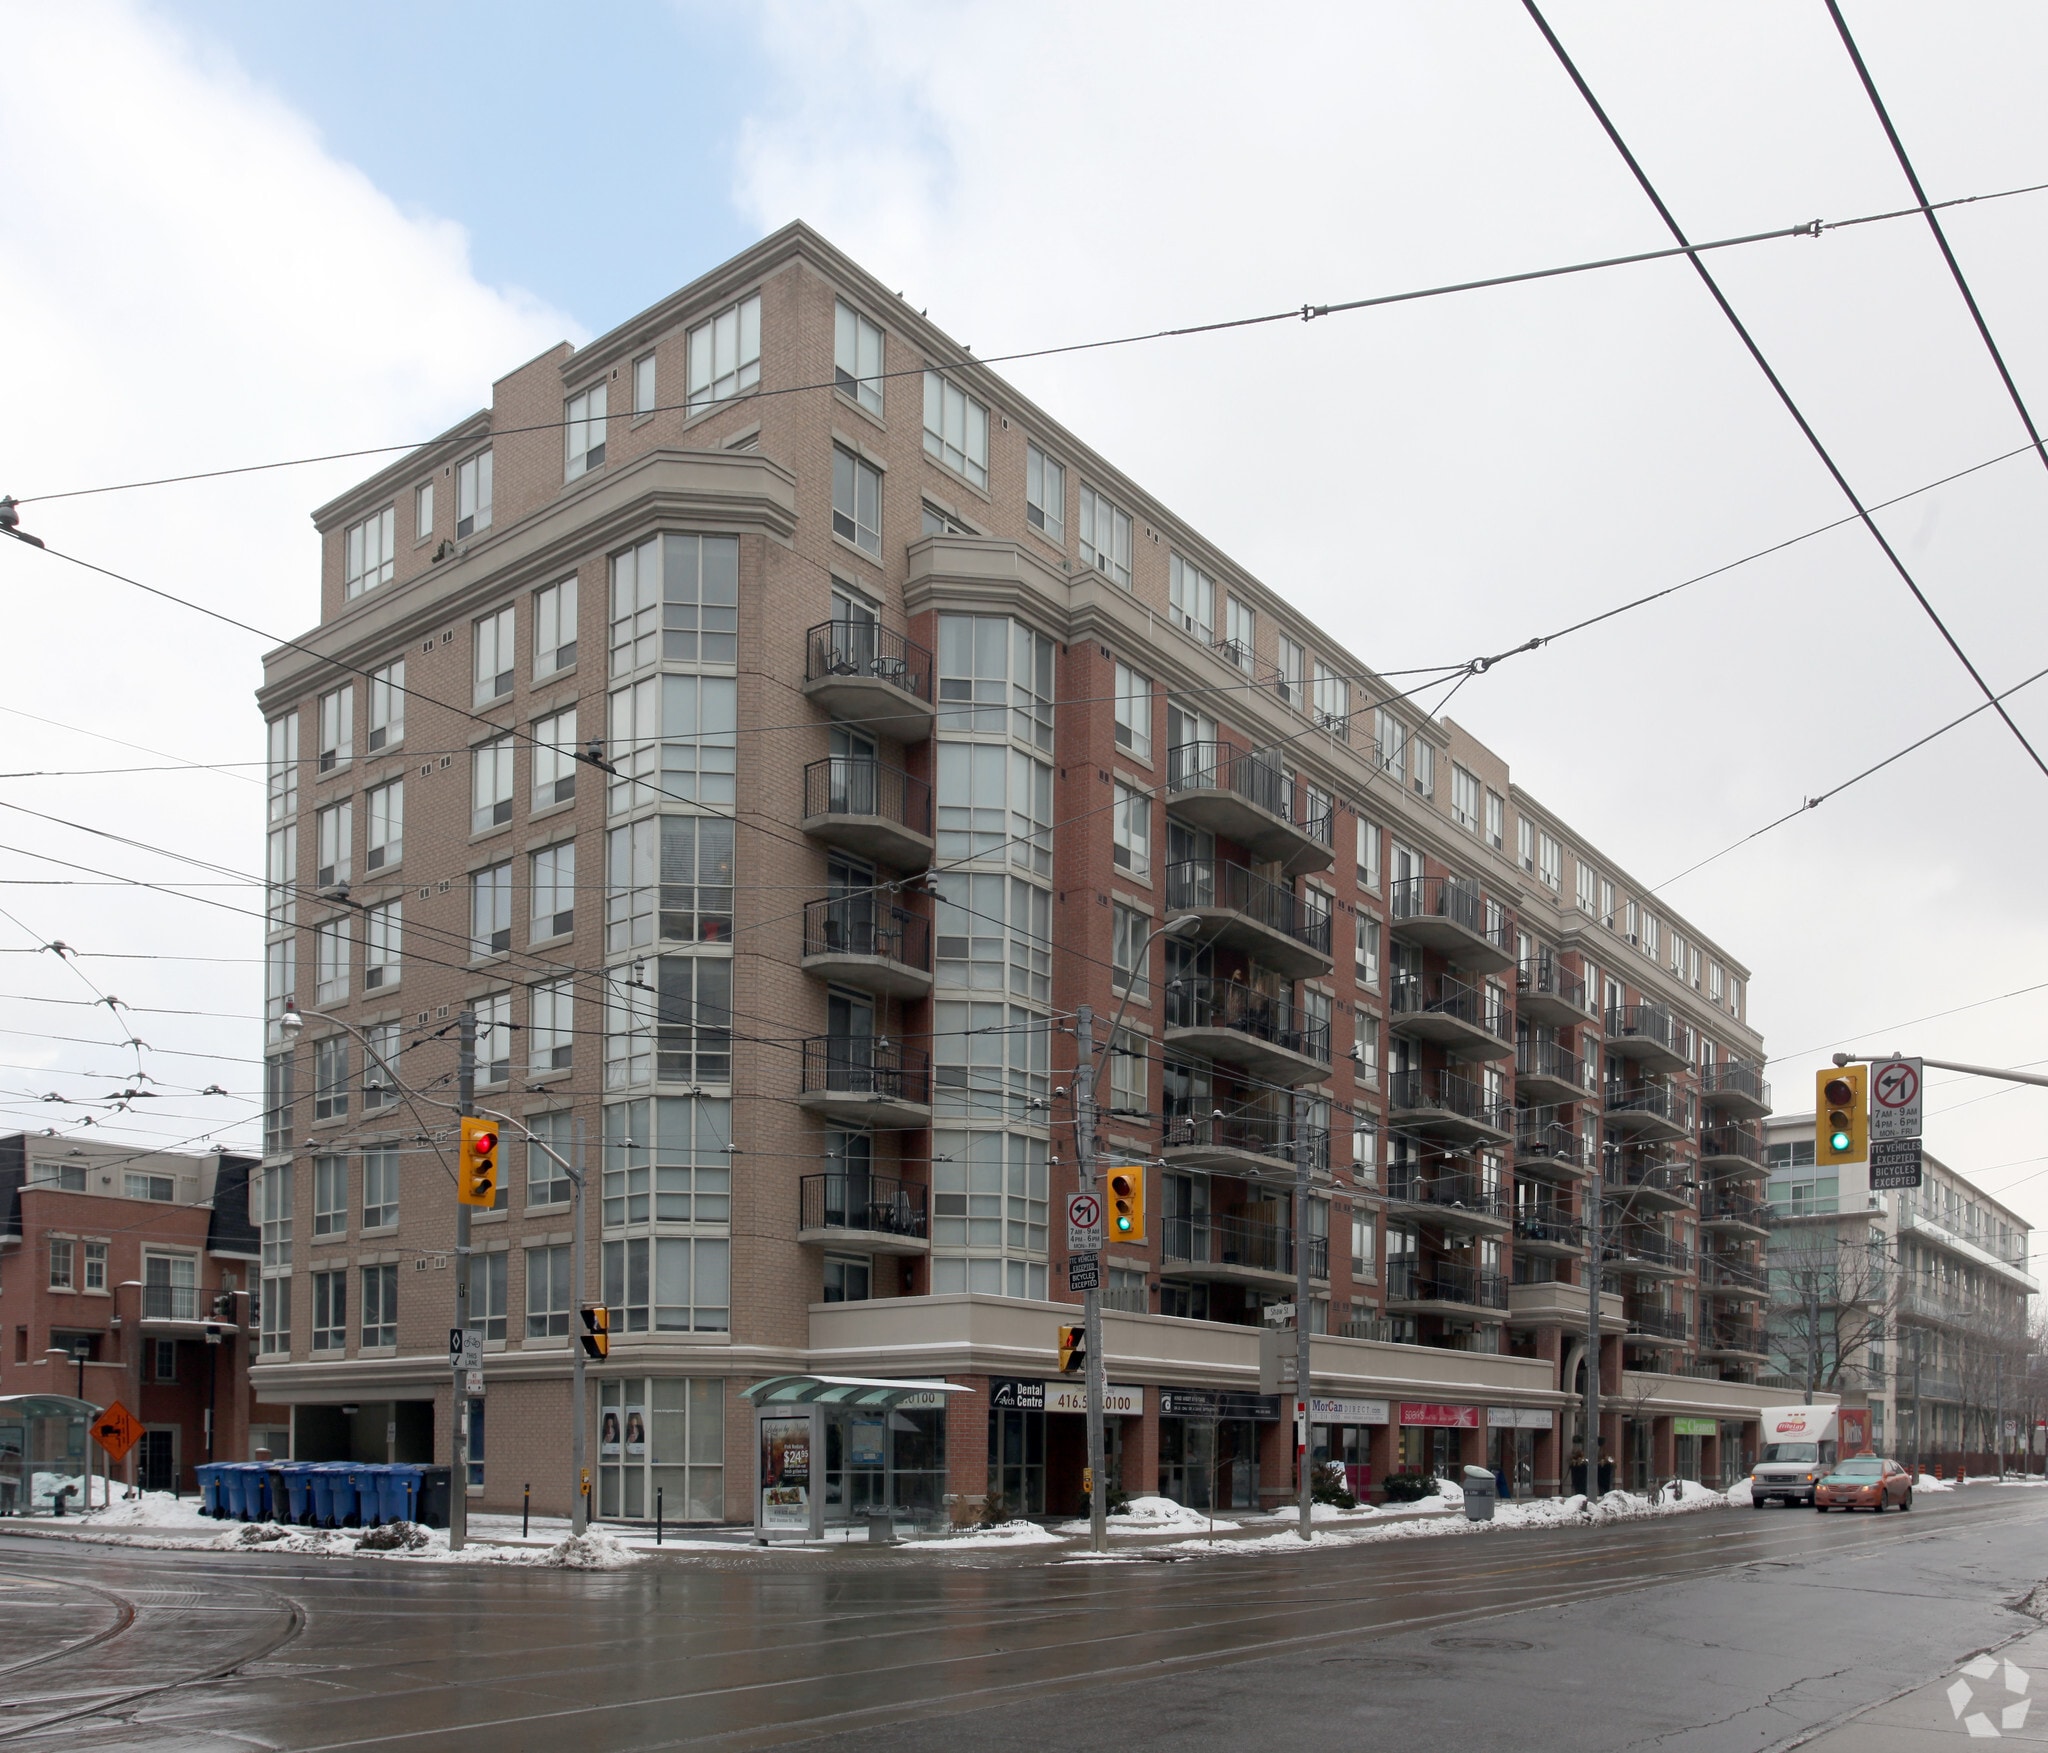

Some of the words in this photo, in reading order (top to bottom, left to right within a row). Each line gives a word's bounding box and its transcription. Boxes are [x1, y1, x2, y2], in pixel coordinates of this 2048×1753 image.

[1872, 1144, 1884, 1153] TTC
[1886, 1141, 1920, 1153] VEHICLES
[1877, 1153, 1914, 1164] EXCEPTED
[1875, 1165, 1915, 1177] BICYCLES
[1874, 1176, 1916, 1188] EXCEPTED
[1072, 1271, 1095, 1282] BICYCLES
[1071, 1279, 1097, 1290] EXCEPTED
[1270, 1308, 1282, 1316] Shaw
[1283, 1306, 1289, 1314] St
[1017, 1383, 1043, 1396] Dental
[1017, 1395, 1043, 1408] Centre
[1312, 1399, 1343, 1412] MorCan
